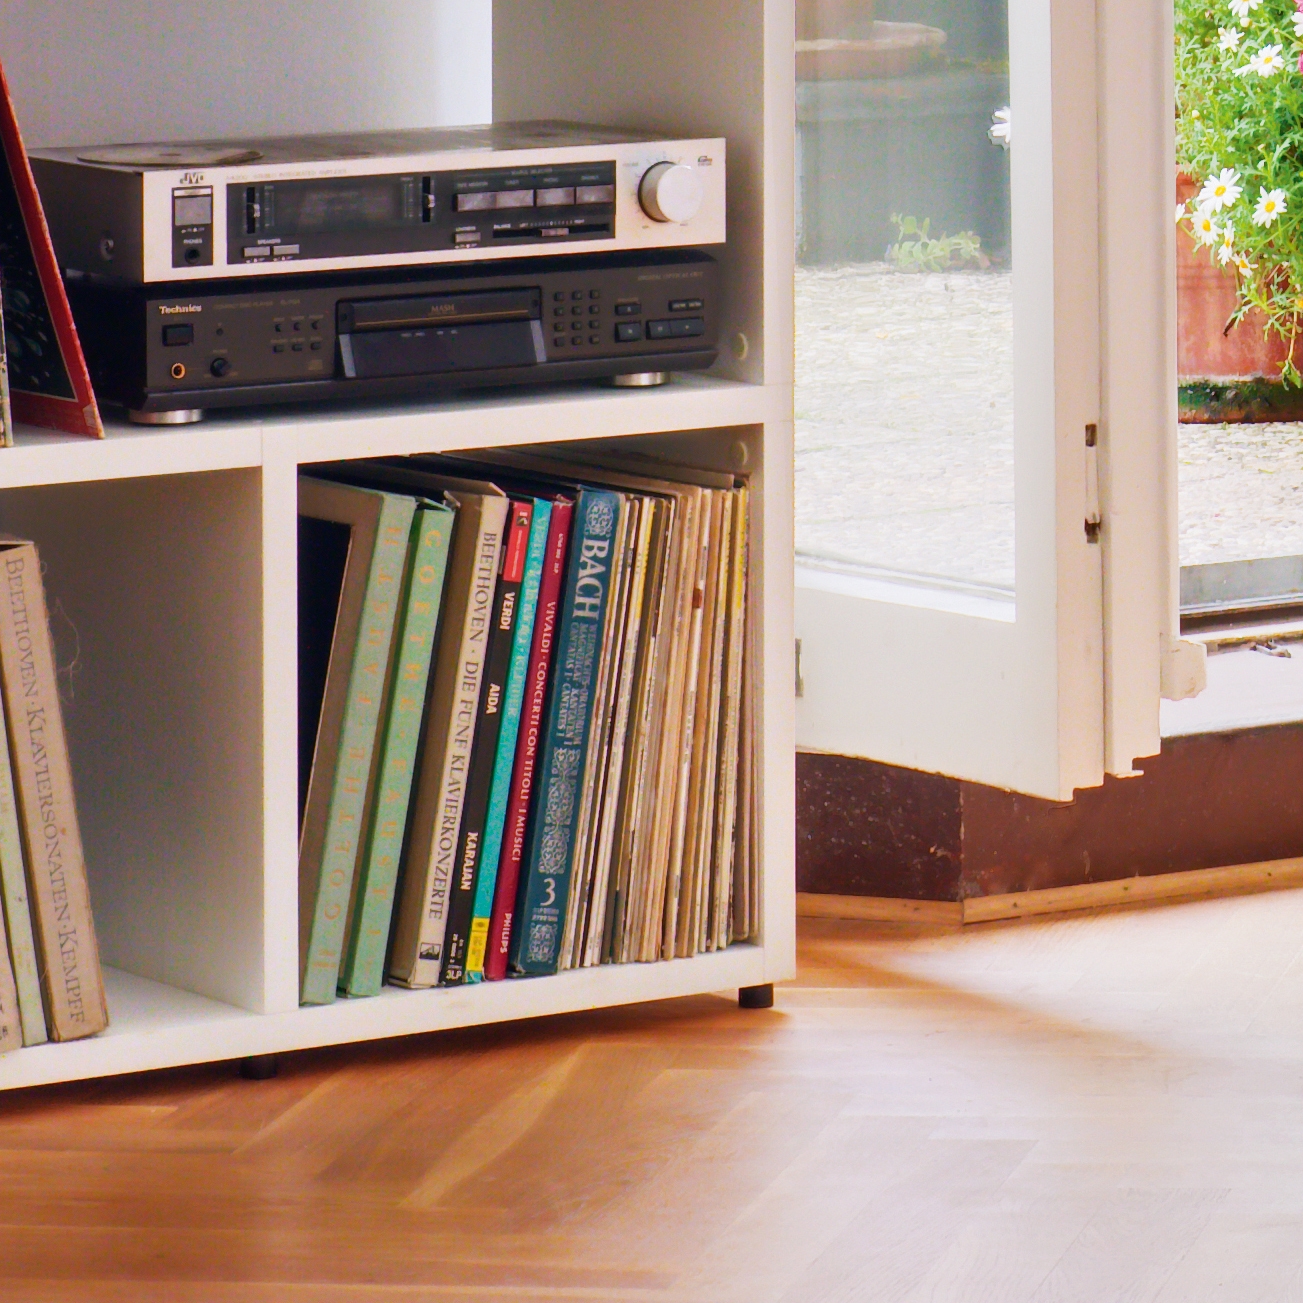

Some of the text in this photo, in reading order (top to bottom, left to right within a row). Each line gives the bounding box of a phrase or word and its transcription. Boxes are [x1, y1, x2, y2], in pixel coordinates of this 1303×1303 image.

[180, 172, 205, 184] JVC
[159, 303, 202, 314] Technics
[431, 303, 455, 312] MASH
[468, 531, 497, 642] BEETHOVEN
[573, 537, 610, 620] BACH
[398, 528, 444, 713] GOETHE
[499, 591, 515, 630] VERDI
[540, 601, 556, 654] VIVALDI
[358, 569, 395, 706] FAUST
[564, 622, 579, 669] CANTATAS
[573, 622, 588, 682] MAGNIFICAT
[462, 661, 479, 692] DIE
[486, 683, 500, 714] AIDA
[530, 662, 549, 725] CONCERTI
[573, 623, 598, 745] WEIHNACHTS-ORATORIUM
[557, 683, 572, 730] CANTATES
[565, 688, 579, 737] KANTATEN
[527, 728, 537, 755] CON
[5, 557, 86, 1024] BEETHOVEN KLAVIERSONATEN KEMPFF
[521, 760, 533, 799] TITOLI
[370, 757, 408, 900] FAUST
[428, 753, 469, 921] KLAVIERKONZERTE
[512, 816, 526, 861] MUSICI
[459, 830, 479, 892] KARAJAN
[540, 878, 556, 906] 3
[500, 912, 512, 954] PHILIPS
[446, 970, 462, 980] 3LP
